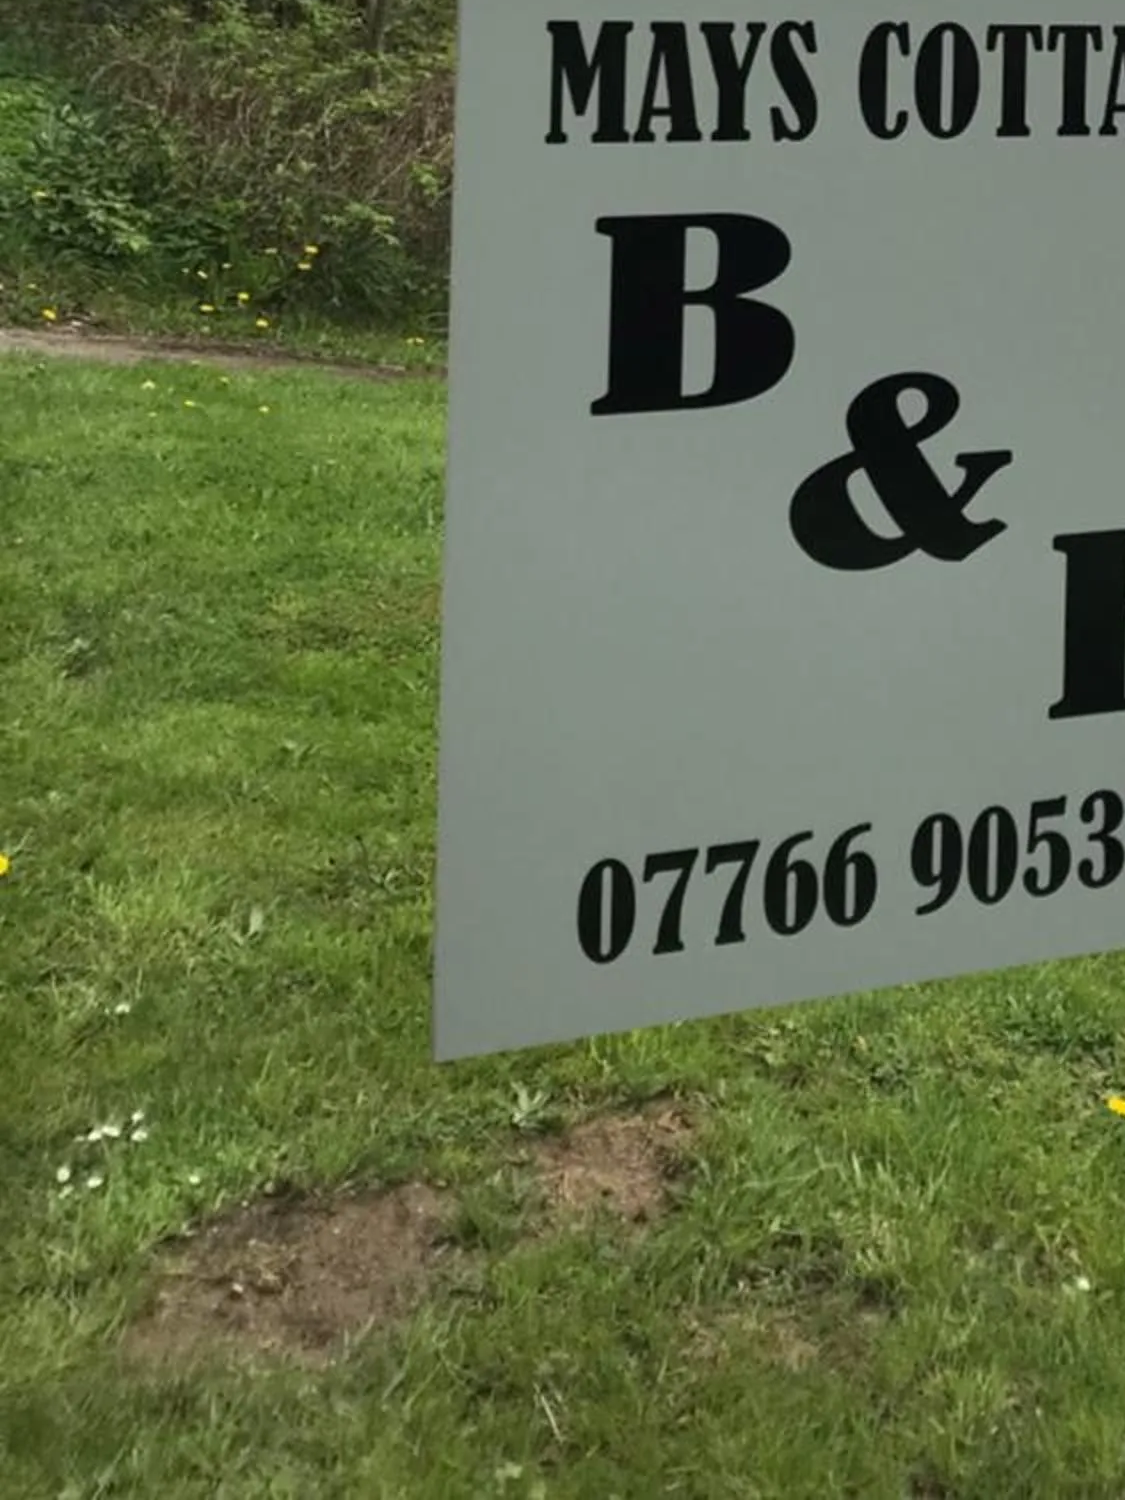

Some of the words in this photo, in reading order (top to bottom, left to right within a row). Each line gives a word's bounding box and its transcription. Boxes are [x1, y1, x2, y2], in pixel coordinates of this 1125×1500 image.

[543, 20, 817, 145] MAYS
[589, 212, 796, 417] B
[788, 371, 1013, 572] &
[576, 822, 878, 965] 07766
